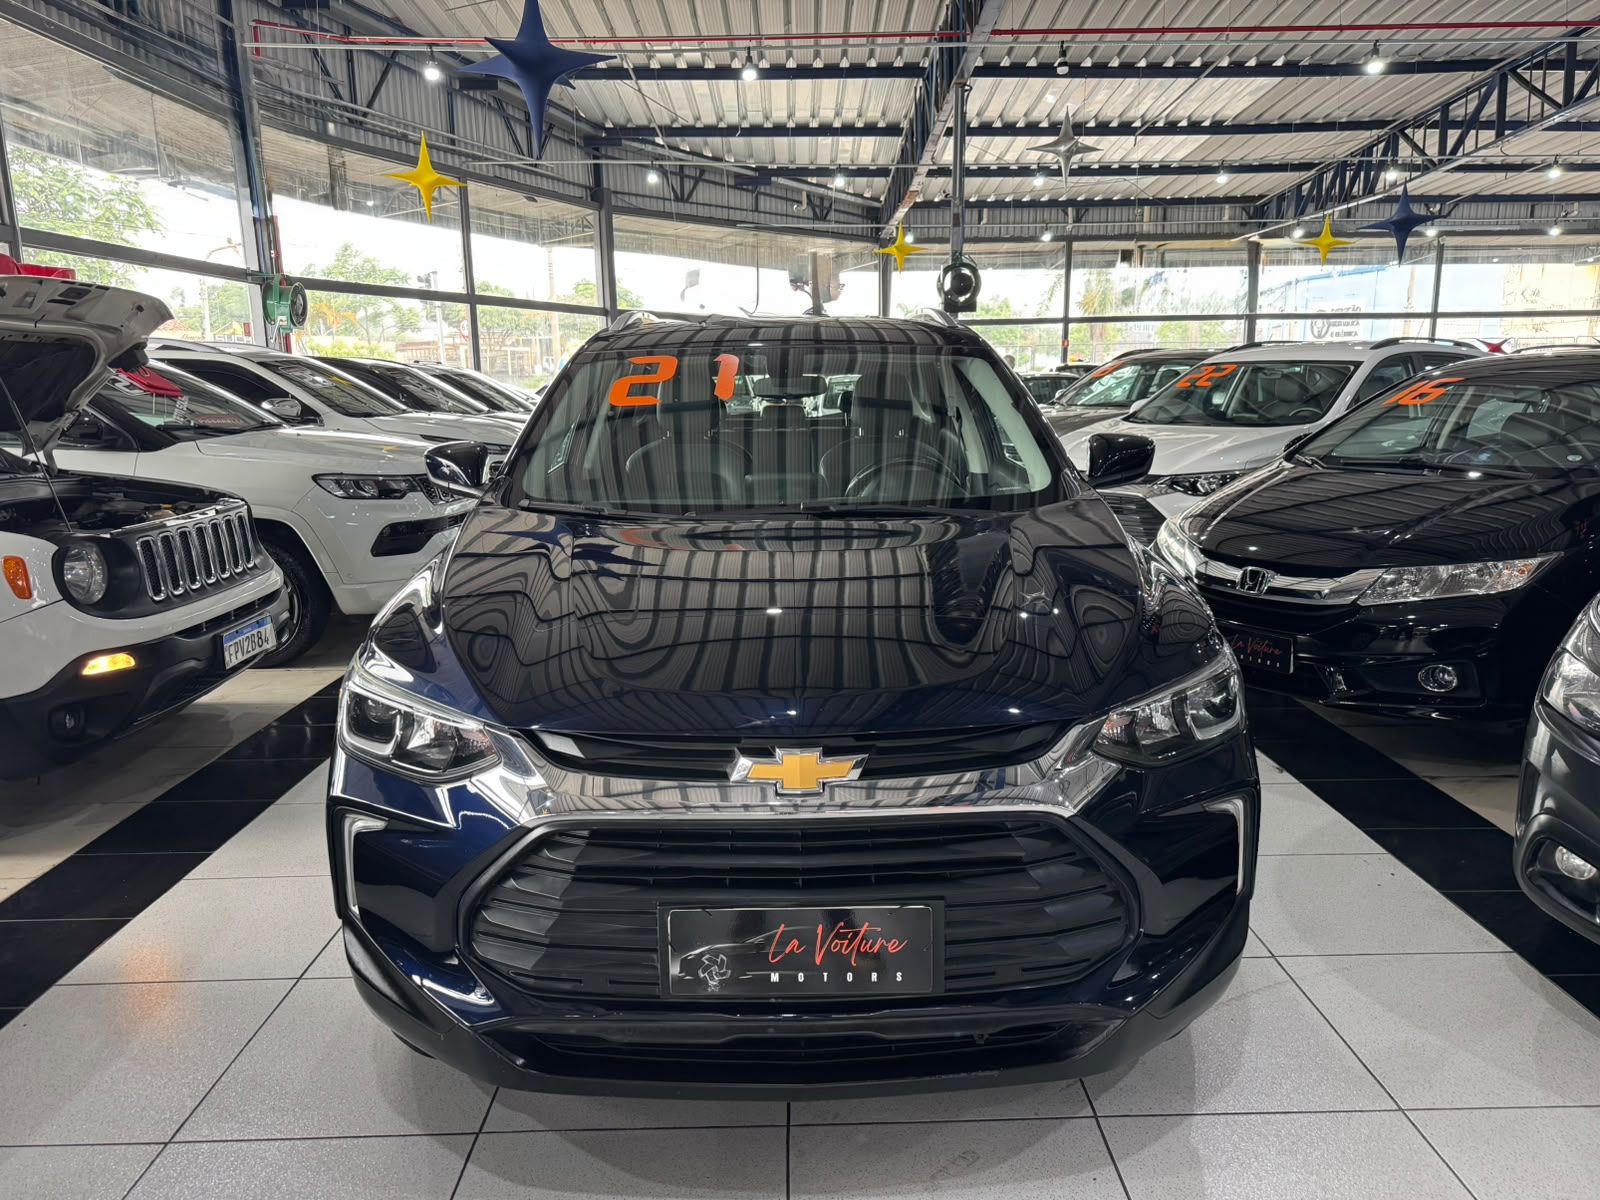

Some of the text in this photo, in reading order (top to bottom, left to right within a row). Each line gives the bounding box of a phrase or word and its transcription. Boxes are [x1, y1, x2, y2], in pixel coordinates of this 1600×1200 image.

[1175, 364, 1238, 388] 22
[1382, 377, 1465, 405] 16
[228, 628, 270, 663] FPV2B84
[768, 921, 908, 966] La Voiture
[770, 972, 903, 983] MOTORS
